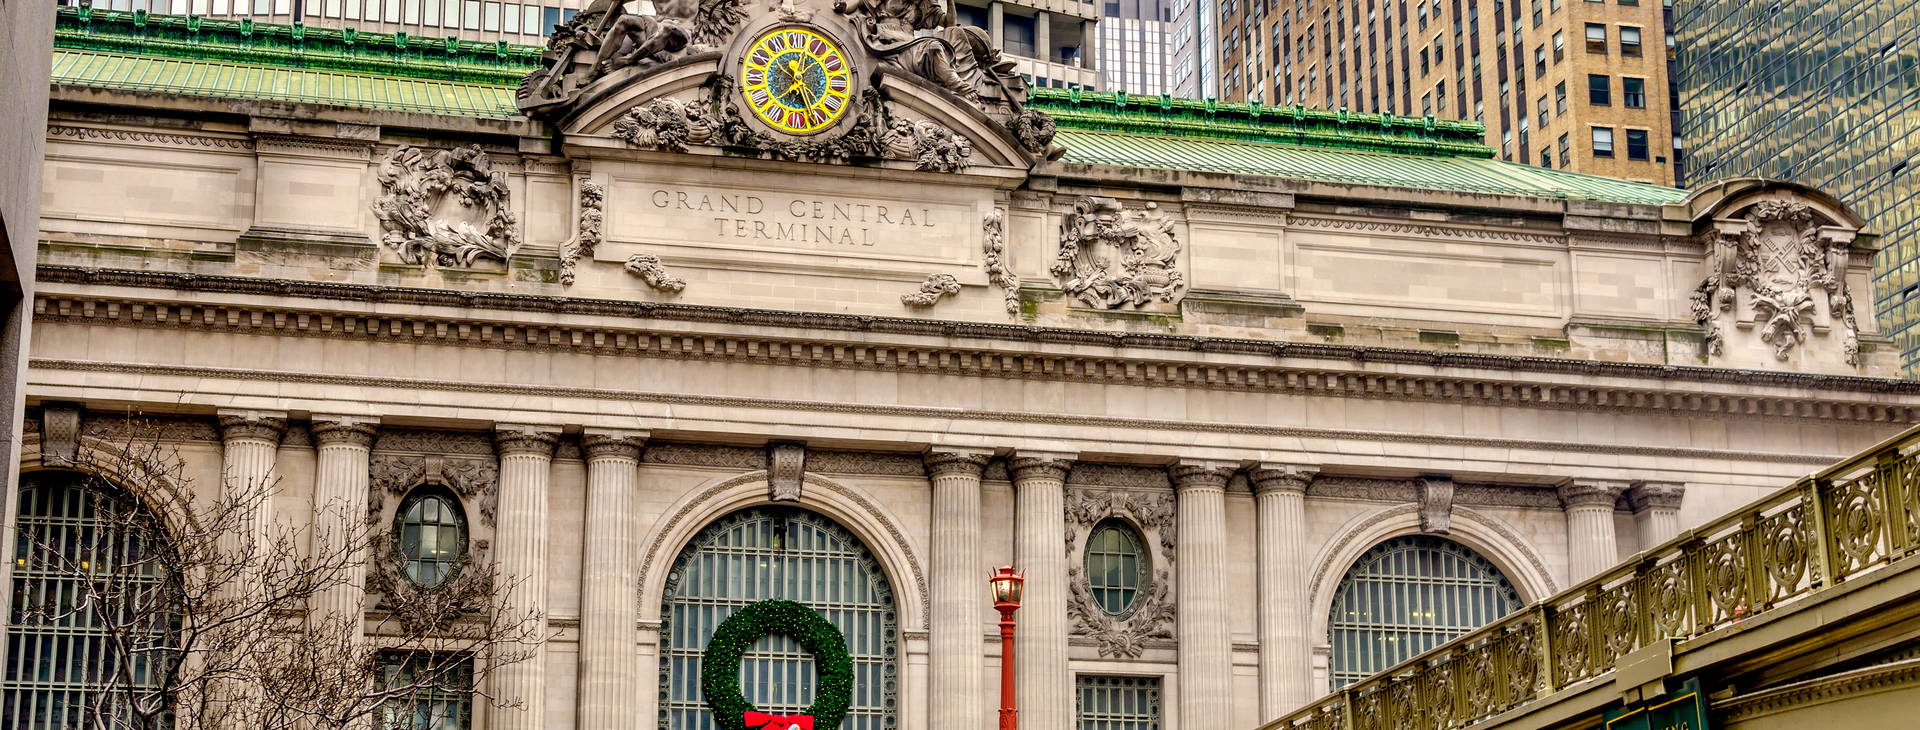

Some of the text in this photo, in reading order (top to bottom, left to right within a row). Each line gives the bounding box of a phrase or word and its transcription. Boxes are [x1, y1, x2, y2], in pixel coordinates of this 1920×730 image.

[792, 33, 803, 49] XII
[651, 189, 935, 227] GRAND CENTRAL
[714, 217, 875, 247] TERMINAL
